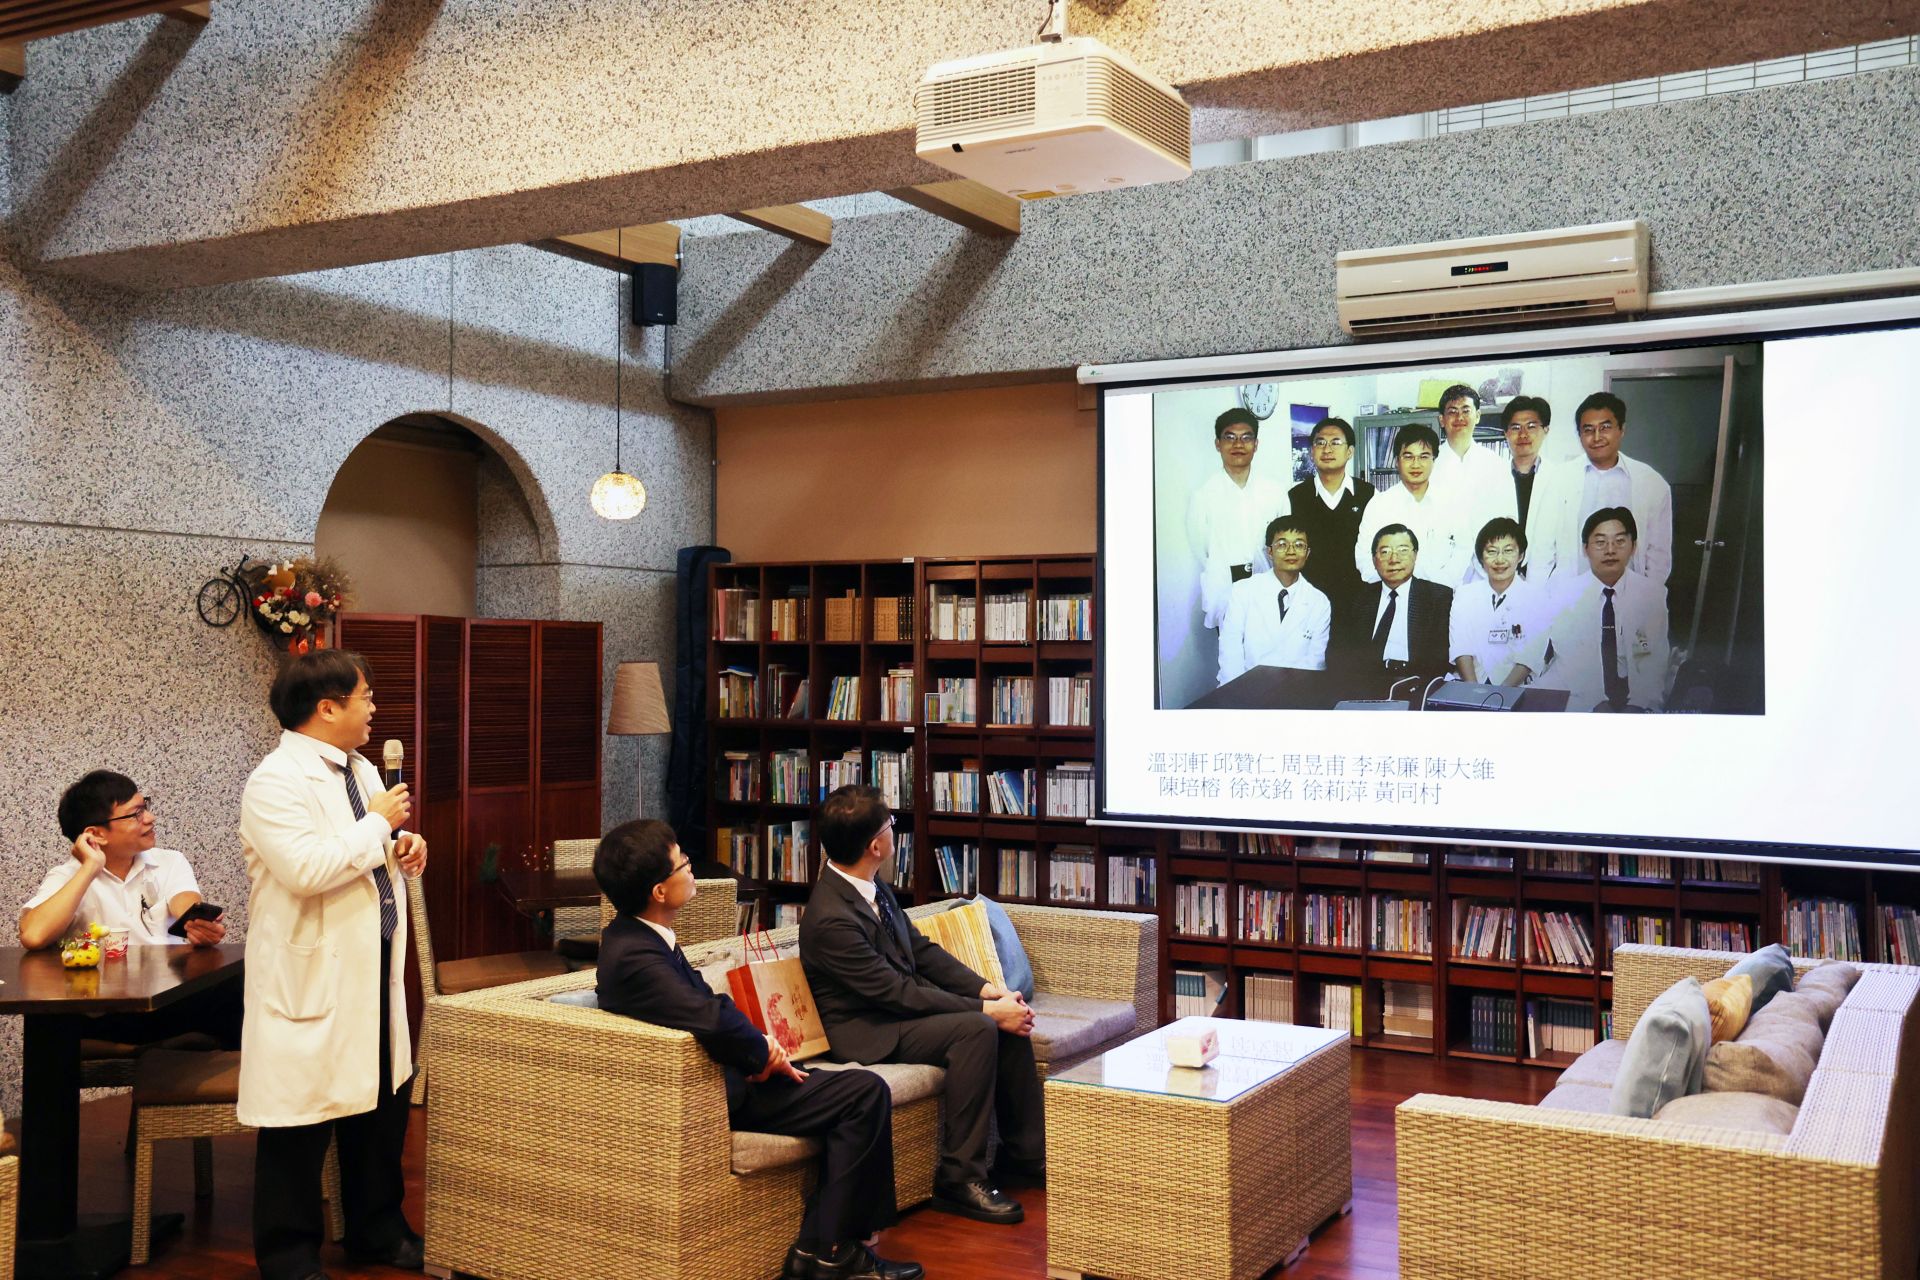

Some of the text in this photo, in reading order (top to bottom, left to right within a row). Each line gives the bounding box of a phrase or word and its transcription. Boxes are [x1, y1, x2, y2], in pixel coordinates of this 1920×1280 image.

[1351, 754, 1420, 778] 李承廉
[1424, 756, 1496, 780] 陳大維
[1159, 776, 1442, 805] 陳培榕 徐茂銘 徐莉萍 黃同村
